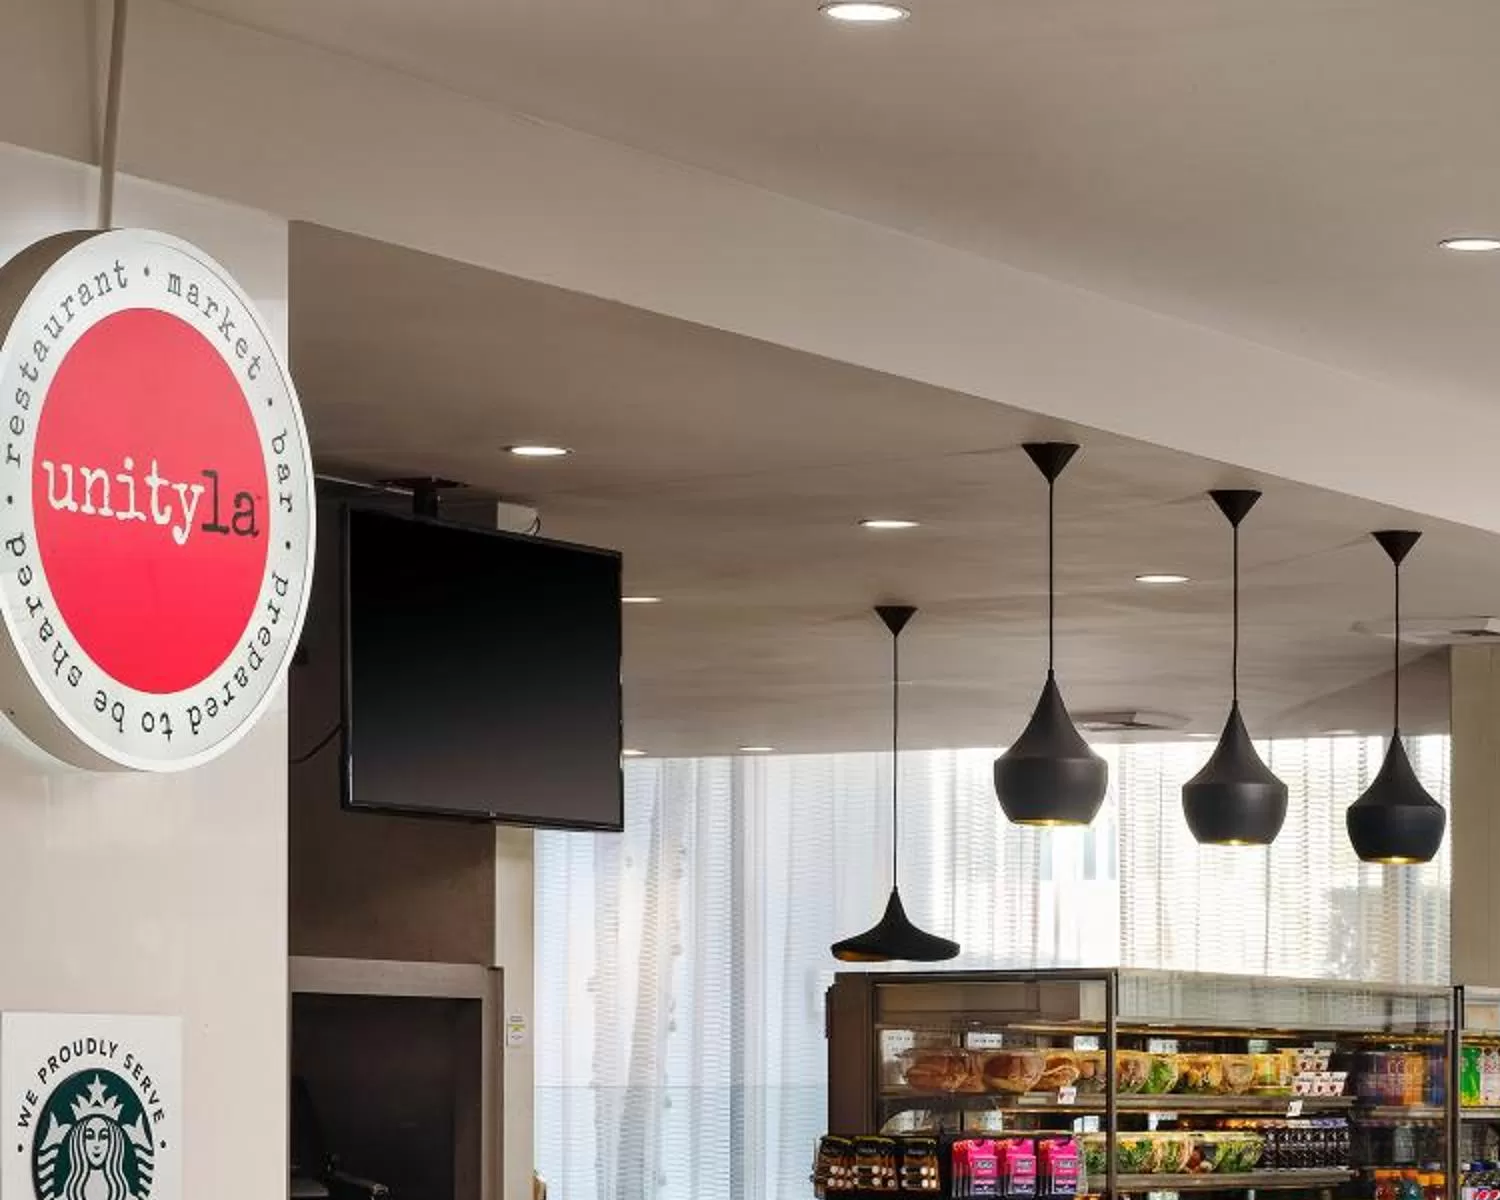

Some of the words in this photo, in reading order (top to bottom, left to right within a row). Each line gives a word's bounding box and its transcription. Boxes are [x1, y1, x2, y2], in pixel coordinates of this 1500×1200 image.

[5, 259, 129, 468] restaurant
[167, 270, 262, 382] market
[271, 427, 293, 514] bar
[5, 532, 83, 687] shared
[186, 572, 290, 736] prepared
[94, 688, 126, 735] be
[142, 708, 174, 742] to
[17, 1089, 39, 1129] WE
[37, 1037, 119, 1084] PROUDLY
[123, 1053, 165, 1124] SERVE
